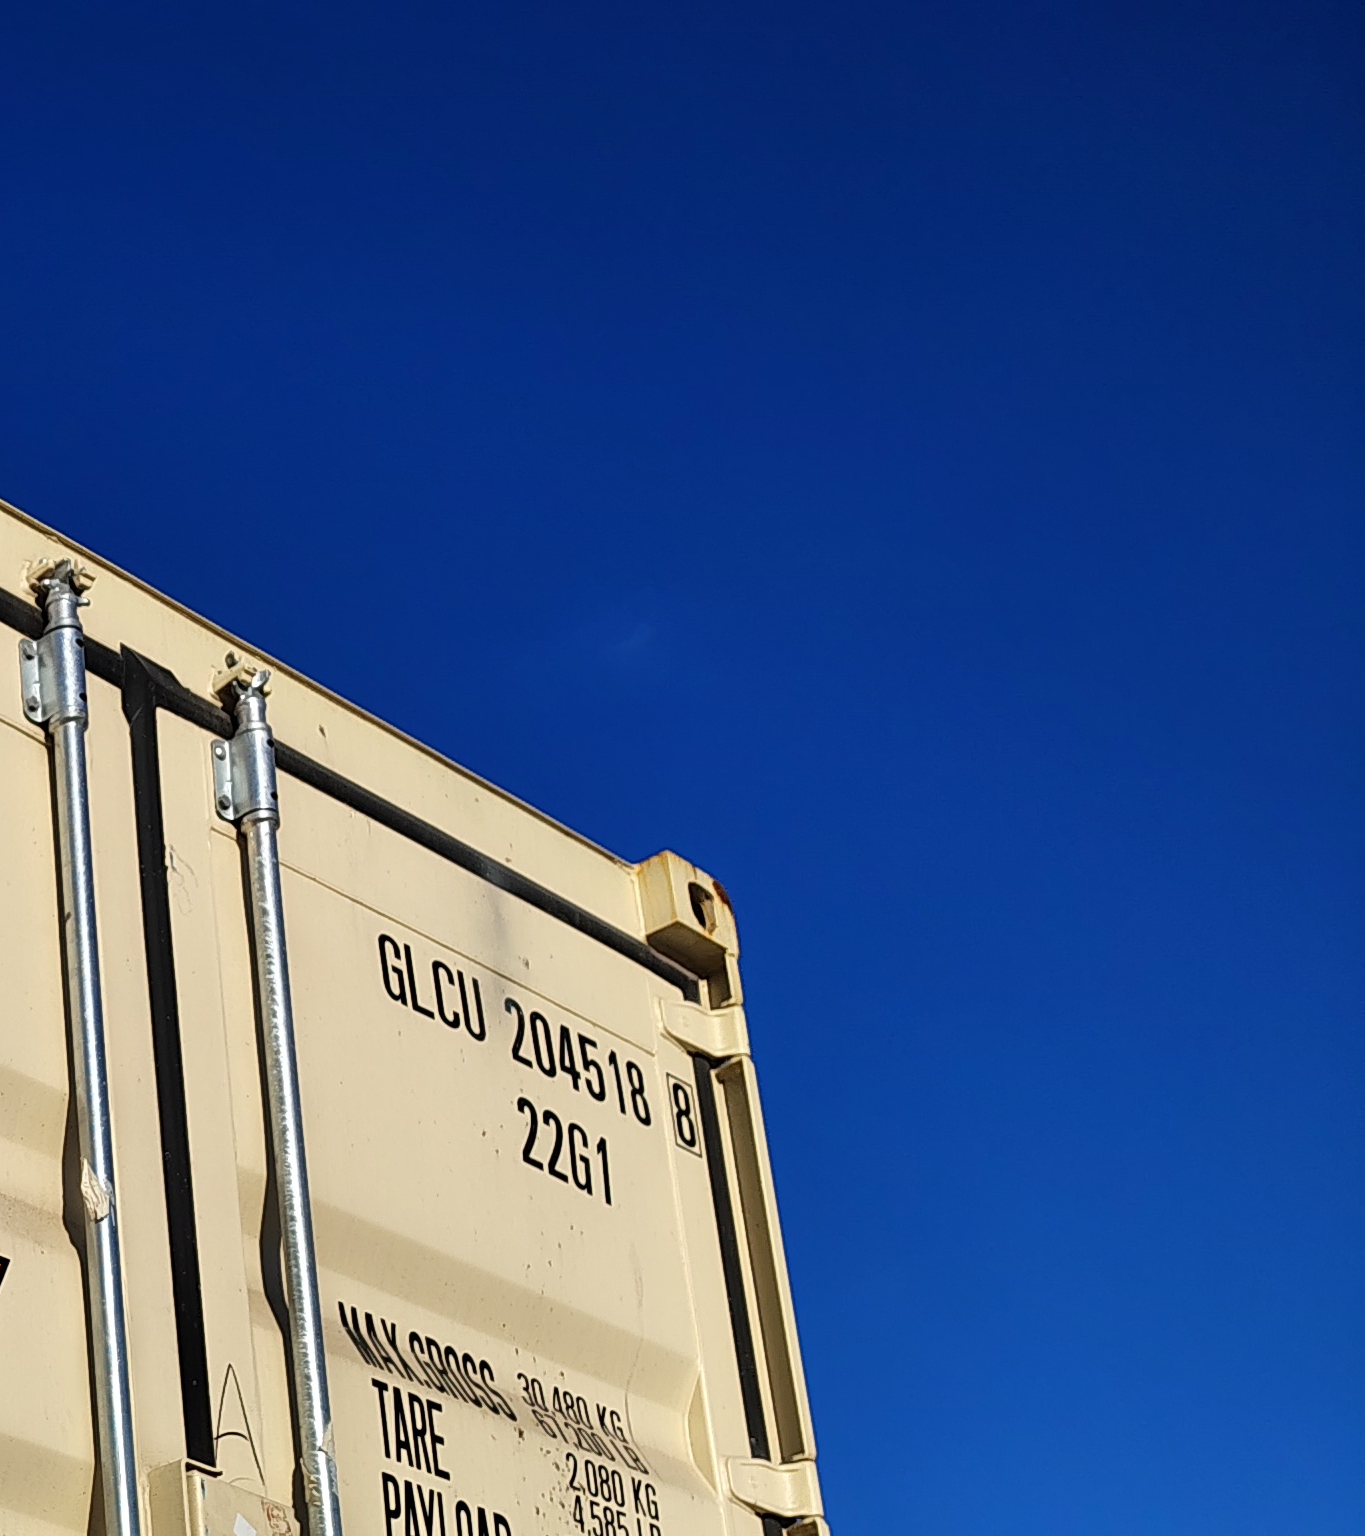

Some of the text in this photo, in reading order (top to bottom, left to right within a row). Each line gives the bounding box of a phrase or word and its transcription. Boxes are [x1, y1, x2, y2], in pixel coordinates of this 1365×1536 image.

[377, 933, 698, 1149] GLCU 204518 8
[517, 1096, 613, 1206] 22G1
[371, 1378, 451, 1481] TARE
[596, 1403, 629, 1444] KG
[609, 1439, 649, 1475] LB
[631, 1476, 659, 1521] KG
